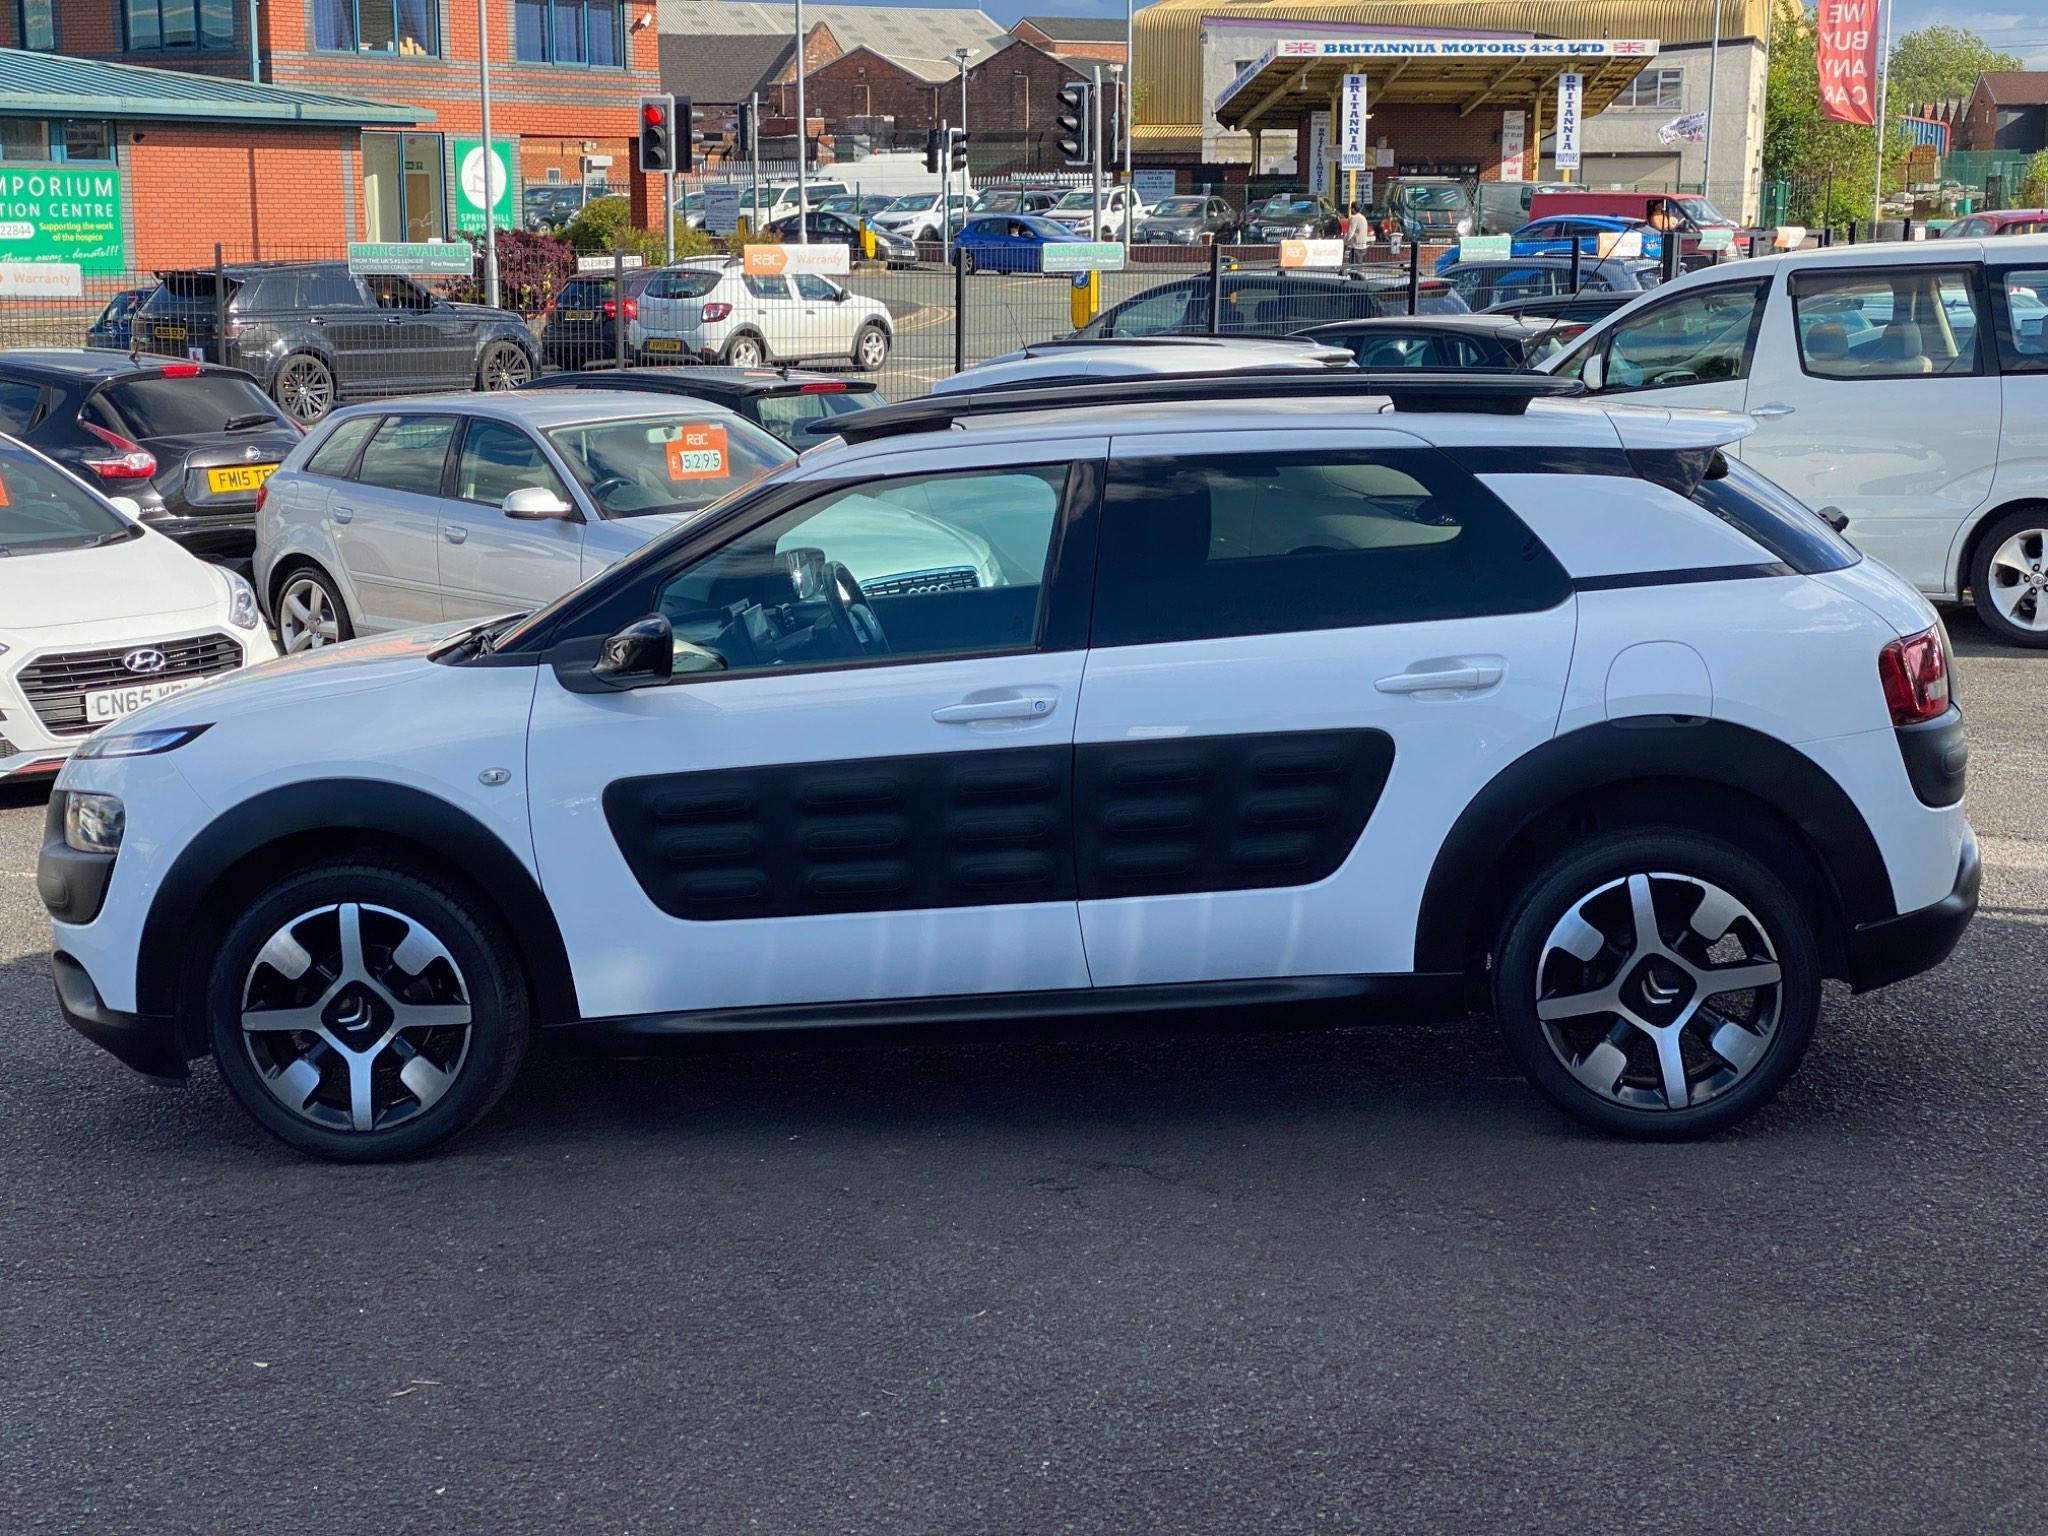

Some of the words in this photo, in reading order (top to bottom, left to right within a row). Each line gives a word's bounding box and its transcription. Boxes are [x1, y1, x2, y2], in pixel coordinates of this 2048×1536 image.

[1323, 43, 1436, 54] BRITANNIA
[1441, 43, 1527, 54] MOTORS
[1568, 43, 1605, 54] LTD
[1348, 76, 1360, 152] BRITANNIA
[1562, 75, 1577, 150] BRITANNIA
[49, 203, 114, 218] CENTRE
[39, 222, 81, 232] Supporting
[82, 222, 94, 230] the
[96, 222, 114, 230] work
[52, 233, 61, 241] of
[62, 233, 74, 241] the
[75, 233, 103, 243] hospice
[351, 246, 404, 257] FINANCE
[406, 246, 469, 257] AVAILABLE
[796, 254, 842, 266] Warranty
[13, 273, 71, 285] Warranty
[683, 453, 720, 470] 5295
[218, 471, 251, 488] FM15
